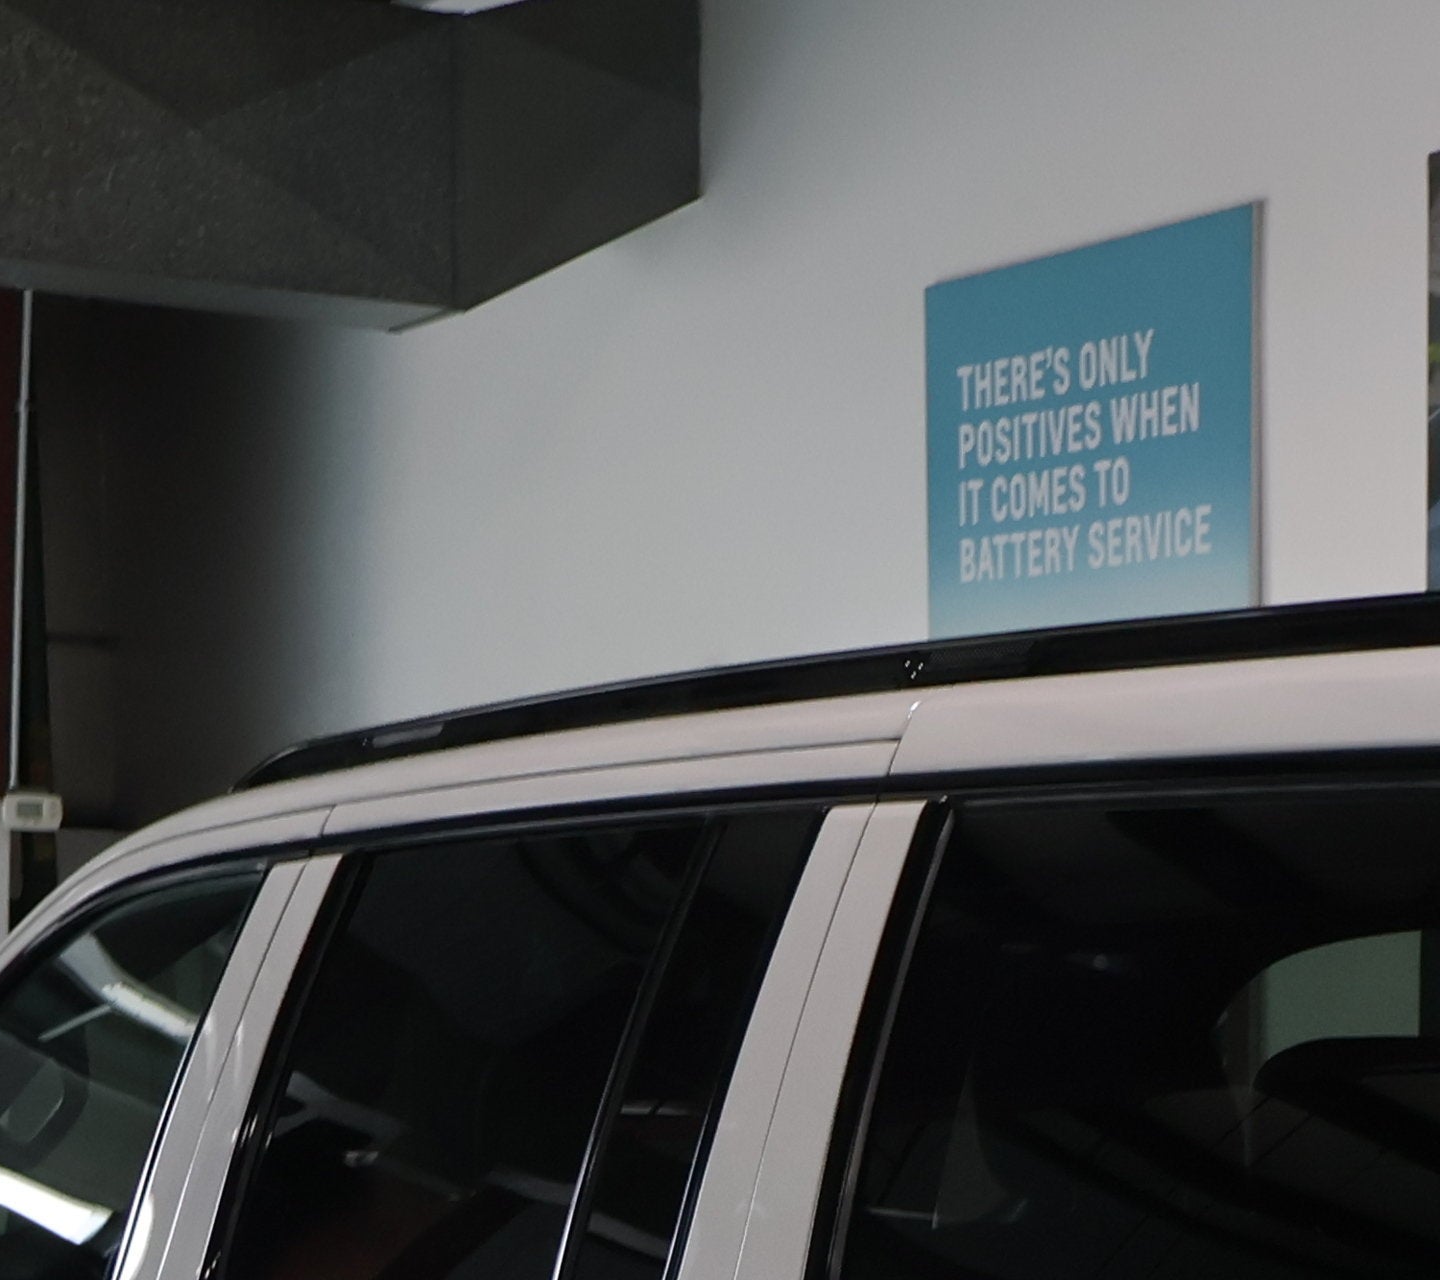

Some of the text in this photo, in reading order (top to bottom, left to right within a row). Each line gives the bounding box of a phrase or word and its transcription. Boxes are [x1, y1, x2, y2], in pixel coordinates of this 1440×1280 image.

[956, 328, 1155, 411] THERE'S ONLY
[958, 382, 1200, 469] POSITIVES WHEN
[958, 456, 1130, 527] IT COMES TO
[959, 504, 1212, 584] BATTERY SERVICE
